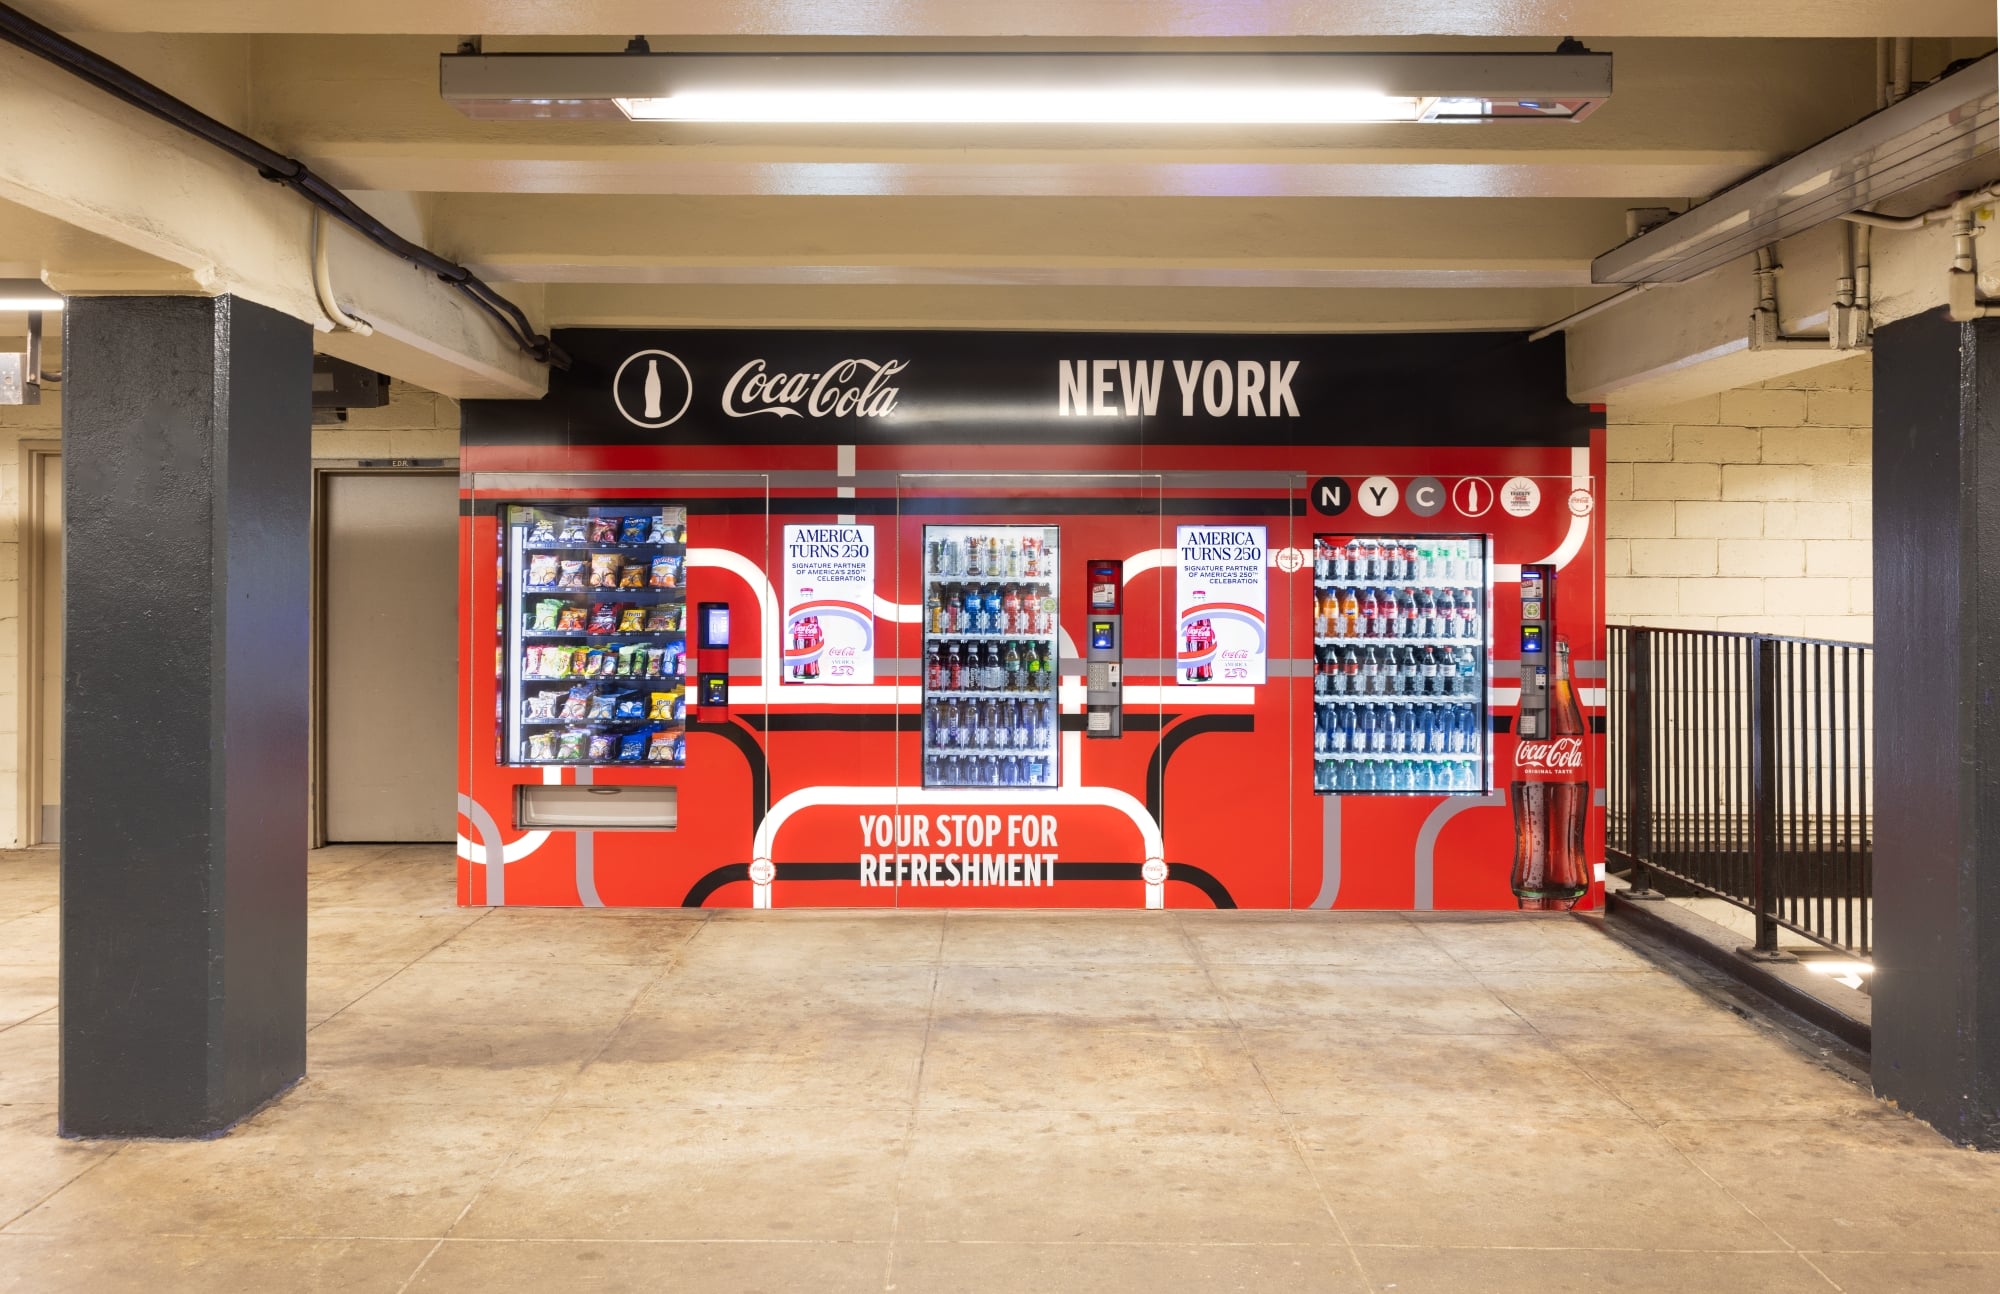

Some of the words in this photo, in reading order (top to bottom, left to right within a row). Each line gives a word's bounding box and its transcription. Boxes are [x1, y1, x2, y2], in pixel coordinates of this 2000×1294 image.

[722, 358, 910, 419] Coca-Cola
[1058, 359, 1164, 417] NEW
[1173, 360, 1301, 418] YORK
[1321, 486, 1341, 507] N
[1369, 486, 1388, 507] Y
[1416, 486, 1436, 507] C
[795, 529, 863, 543] AMERICA
[1187, 531, 1255, 545] AMERICA
[789, 544, 839, 558] TURNS
[842, 544, 869, 558] 250
[1181, 547, 1231, 561] TURNS
[1234, 547, 1261, 561] 250
[1515, 737, 1583, 769] Coca-Cola
[859, 814, 930, 848] YOUR
[936, 814, 1002, 848] STOP
[1008, 814, 1058, 847] FOR
[860, 853, 1059, 887] REFRESHMENT
